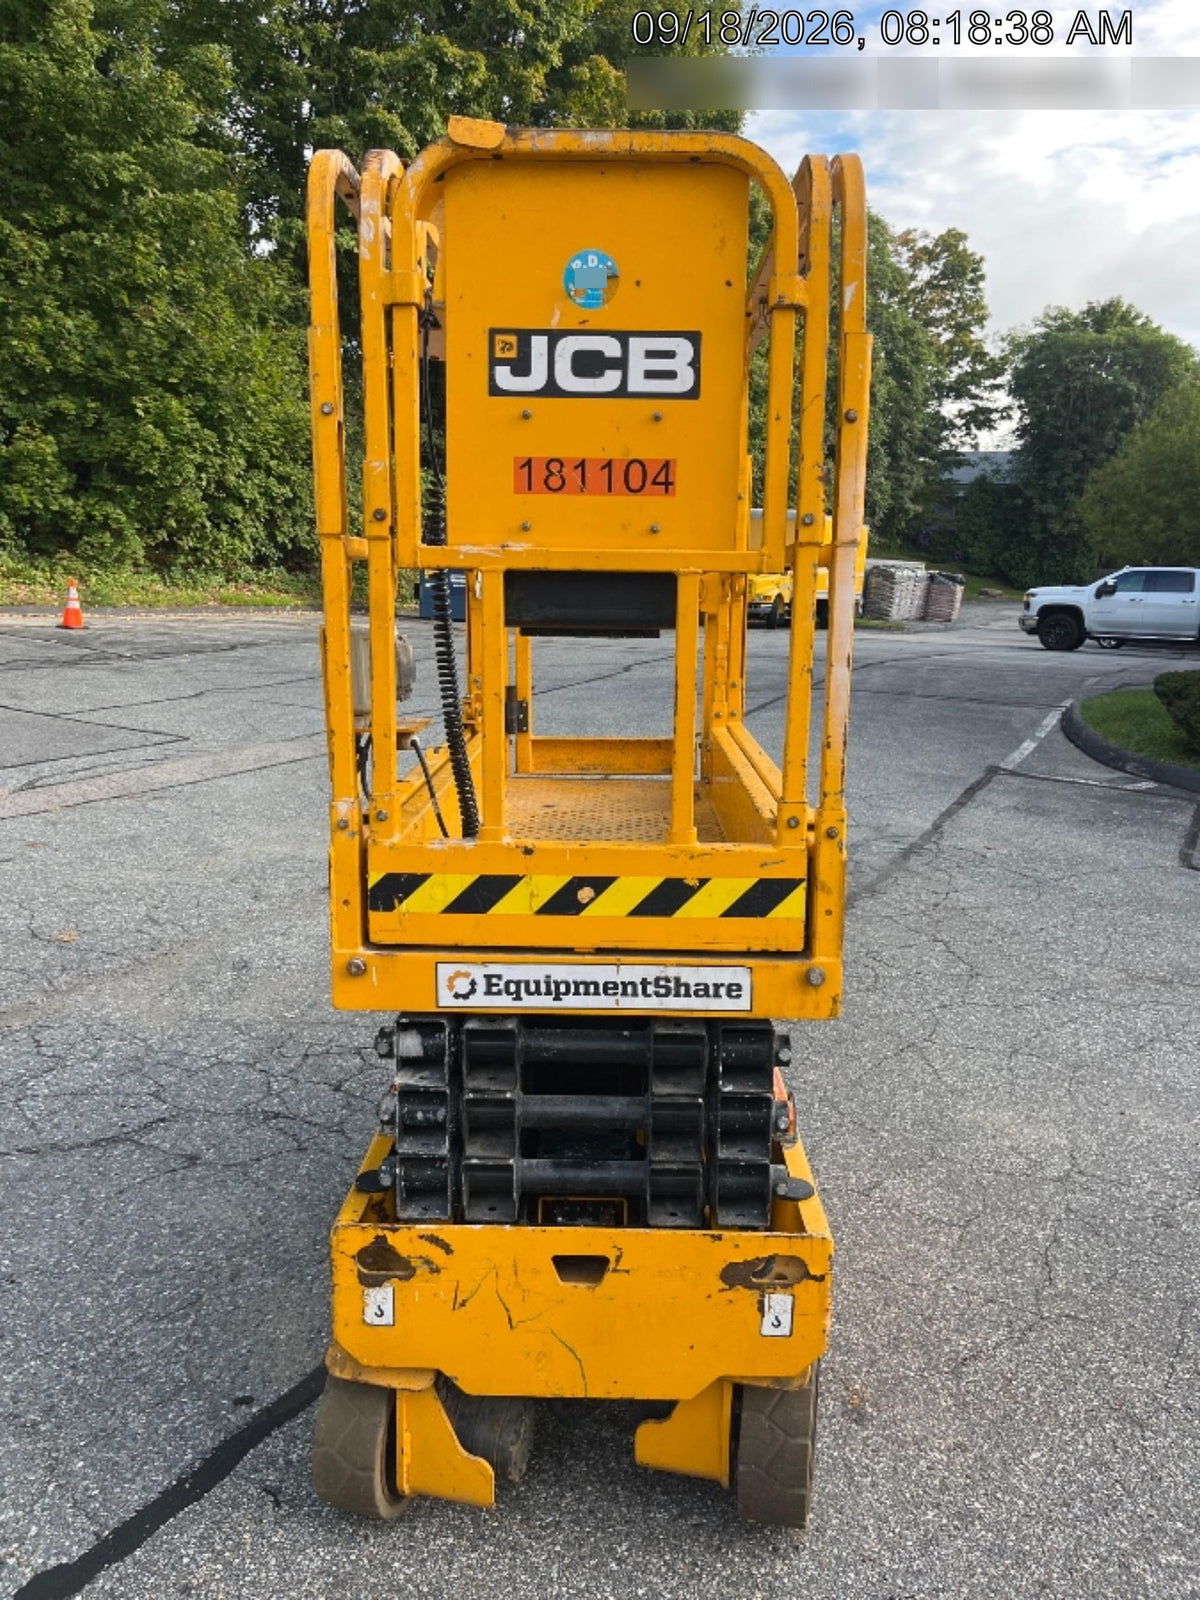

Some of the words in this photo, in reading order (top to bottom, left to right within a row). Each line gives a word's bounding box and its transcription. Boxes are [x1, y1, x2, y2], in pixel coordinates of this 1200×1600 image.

[494, 335, 695, 393] JCB
[518, 457, 674, 494] 181104
[482, 973, 743, 1002] EquipmentShare
